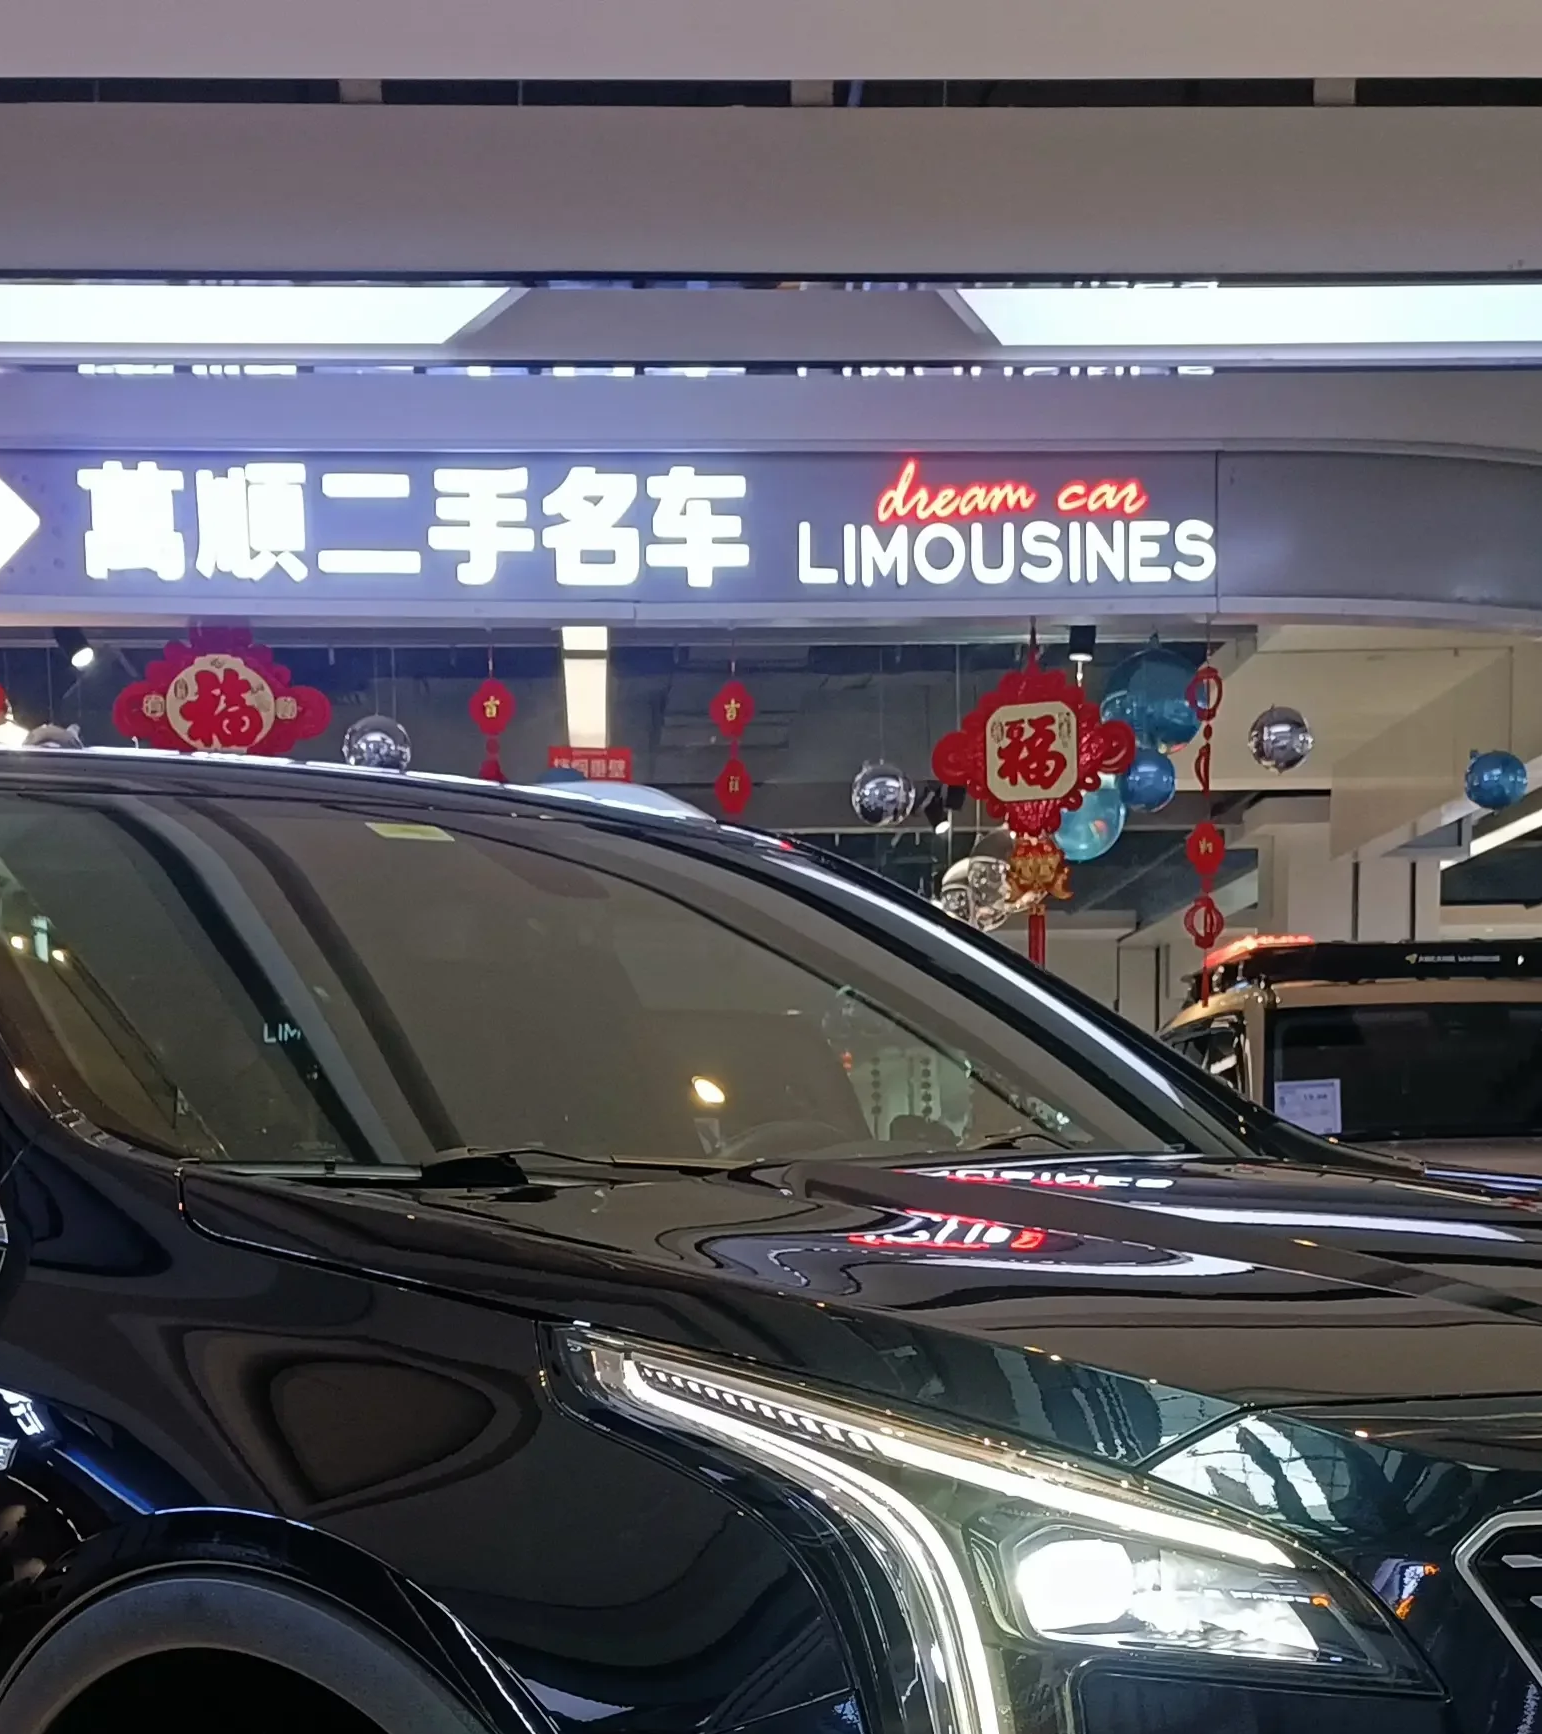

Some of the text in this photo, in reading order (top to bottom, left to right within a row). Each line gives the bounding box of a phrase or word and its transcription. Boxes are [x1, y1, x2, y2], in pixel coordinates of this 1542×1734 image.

[76, 460, 751, 588] 萬順二手名车
[877, 458, 1148, 525] dream car
[796, 519, 1218, 588] LIMOUSINES
[178, 667, 265, 748] 福
[995, 713, 1068, 790] 福
